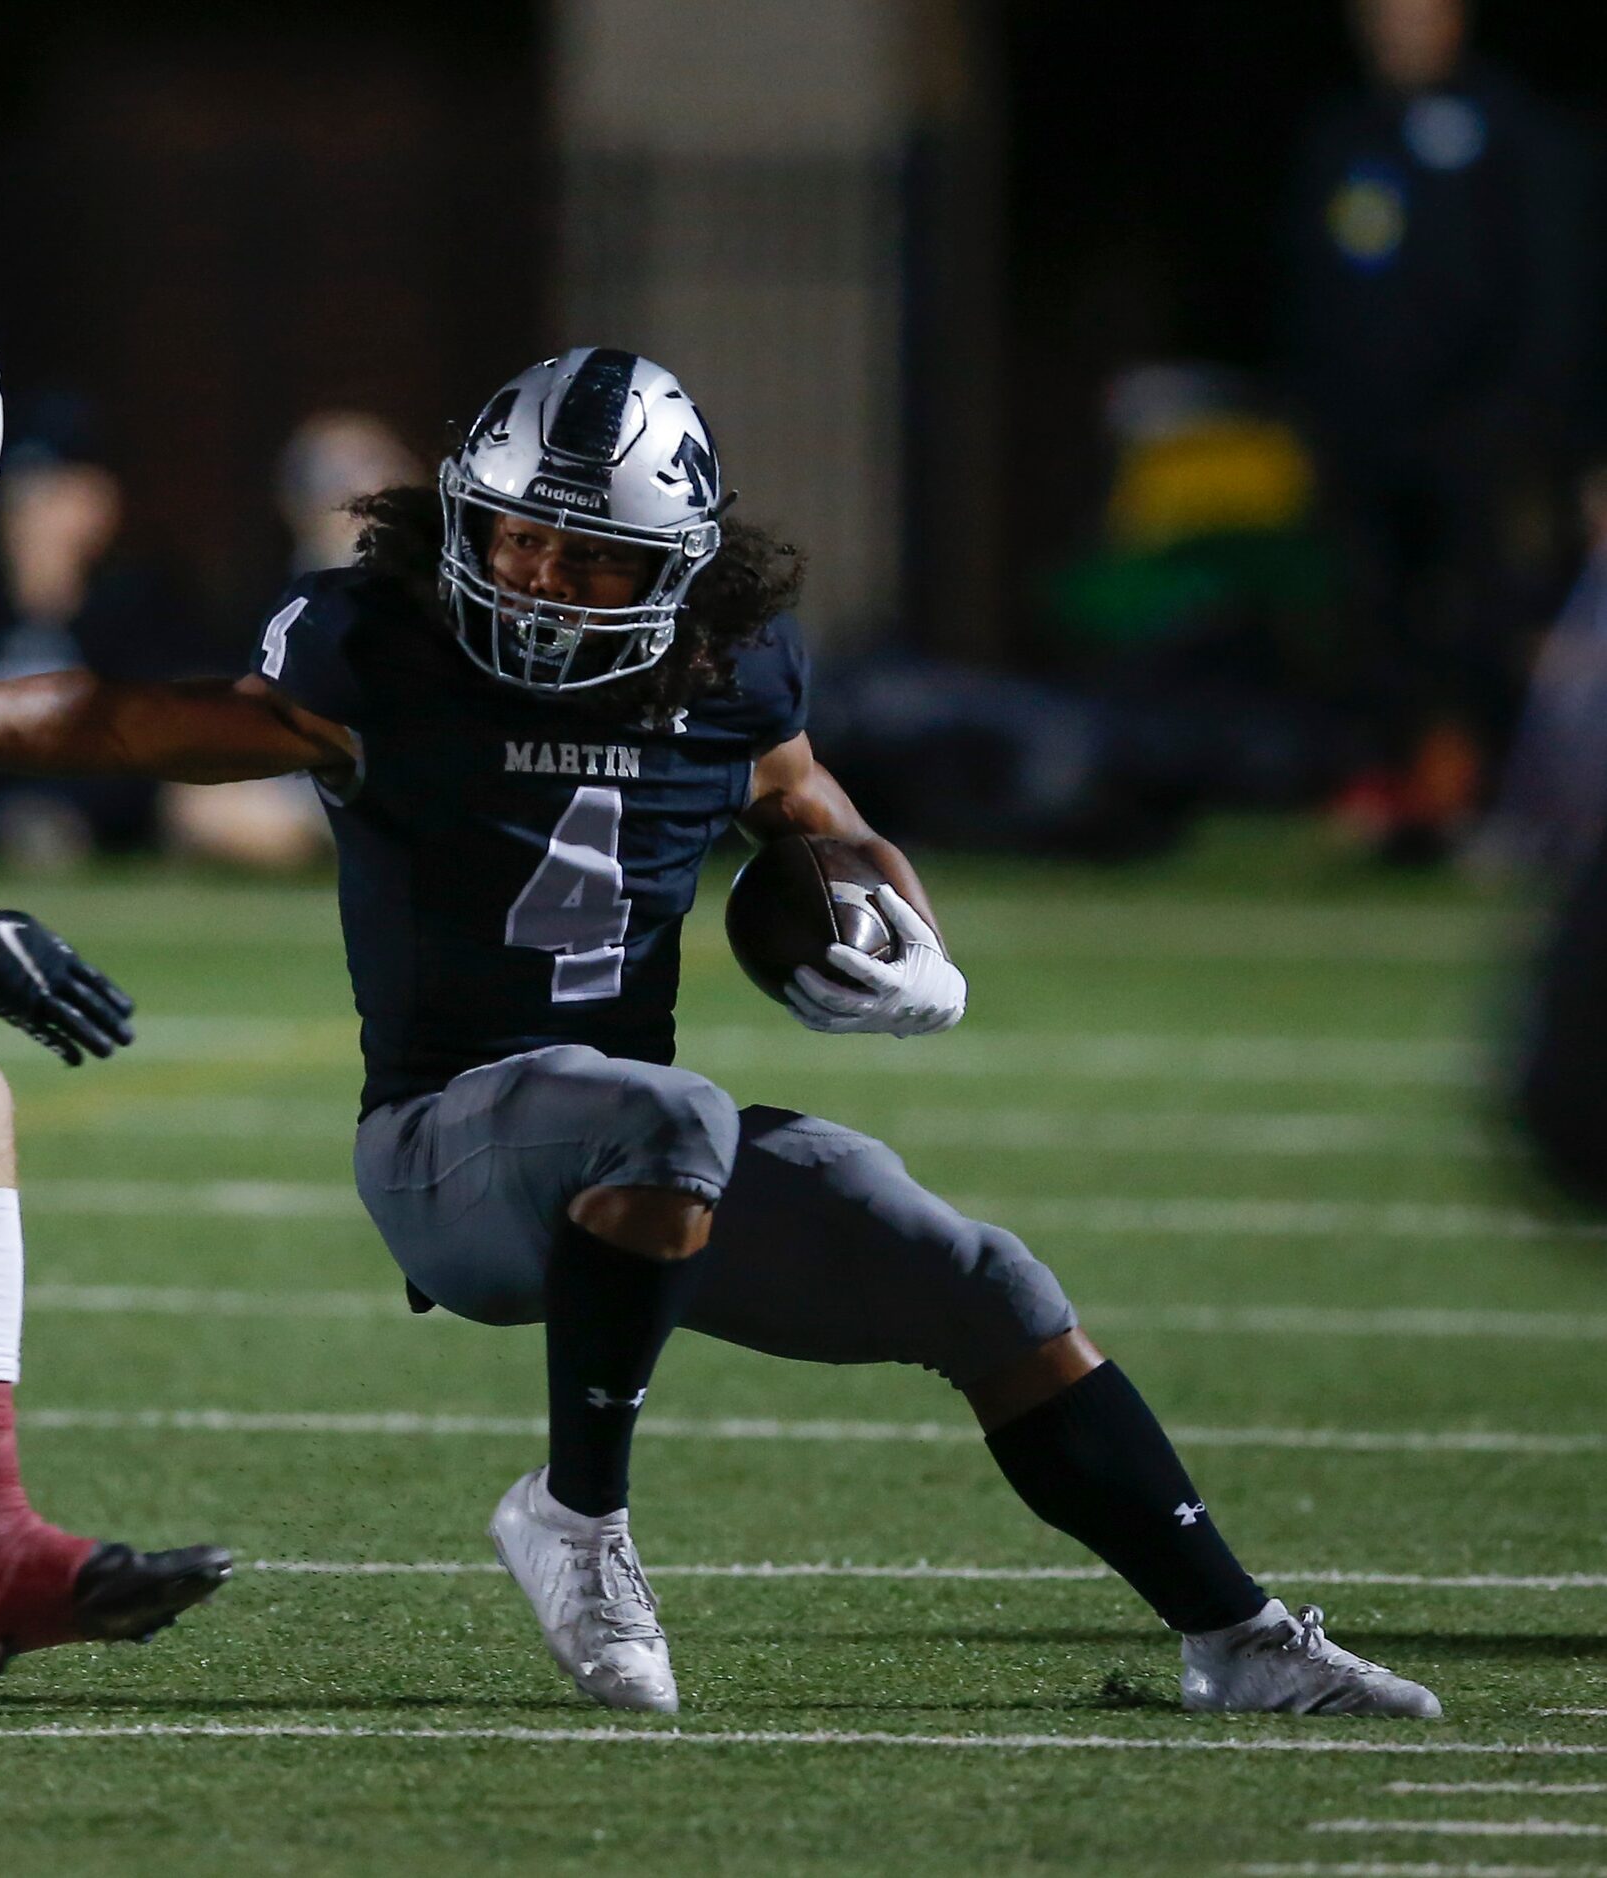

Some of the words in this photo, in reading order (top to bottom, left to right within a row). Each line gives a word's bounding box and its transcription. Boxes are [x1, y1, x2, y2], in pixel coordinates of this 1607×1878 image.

[533, 482, 601, 509] Riddell
[504, 741, 641, 778] MARTIN
[504, 785, 632, 1003] 4
